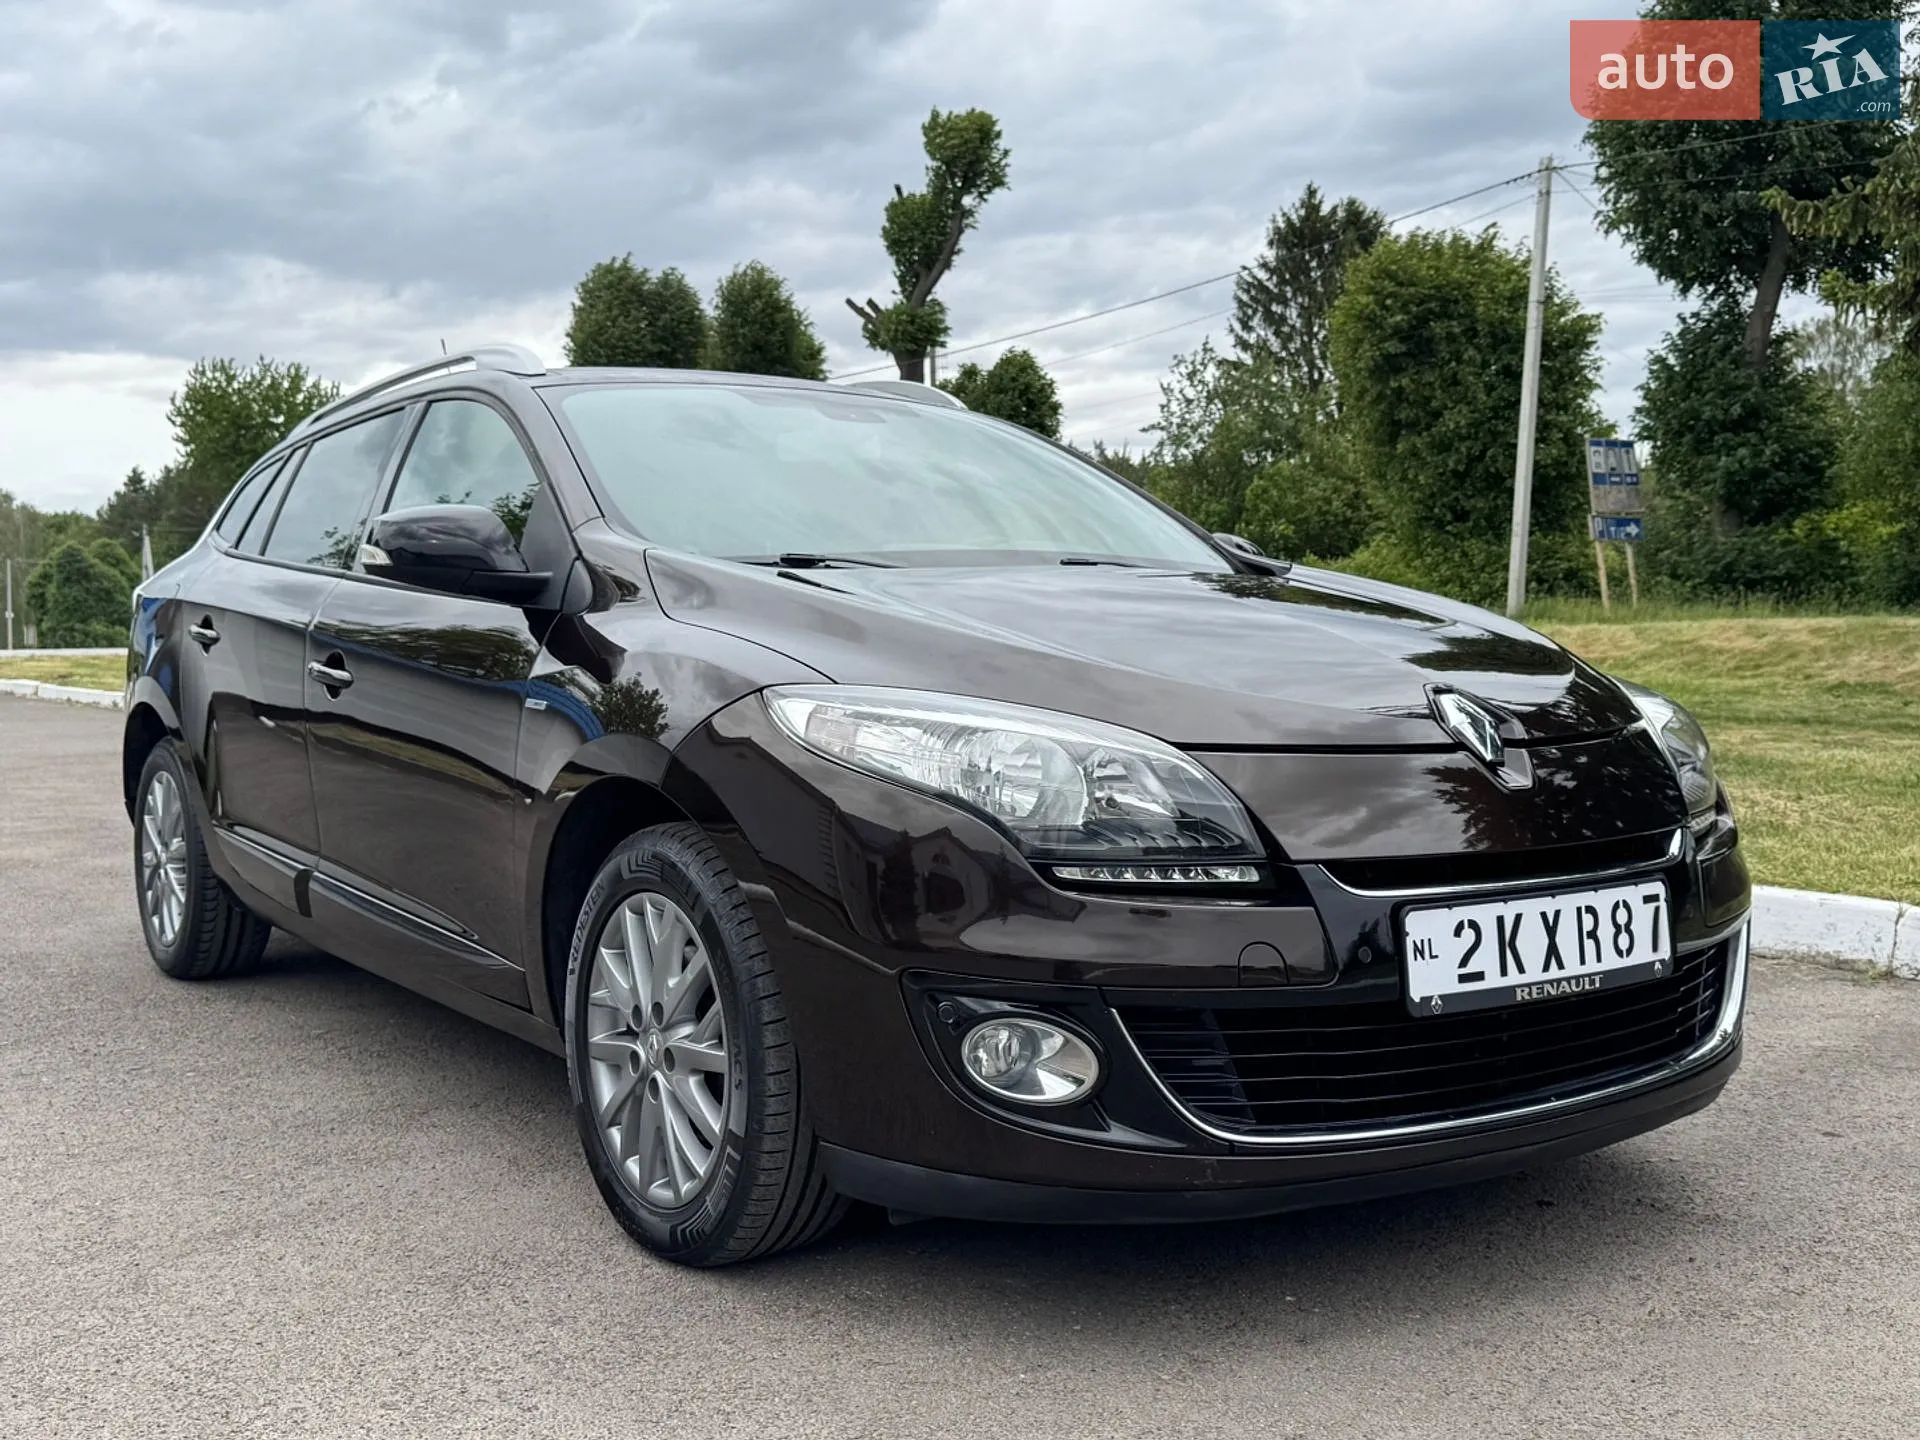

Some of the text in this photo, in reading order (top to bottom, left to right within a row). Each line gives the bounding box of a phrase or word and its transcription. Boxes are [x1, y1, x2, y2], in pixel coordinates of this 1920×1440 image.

[1412, 937, 1439, 961] NL
[1453, 893, 1661, 984] 2KXR87
[1514, 974, 1604, 1001] RENAULT
